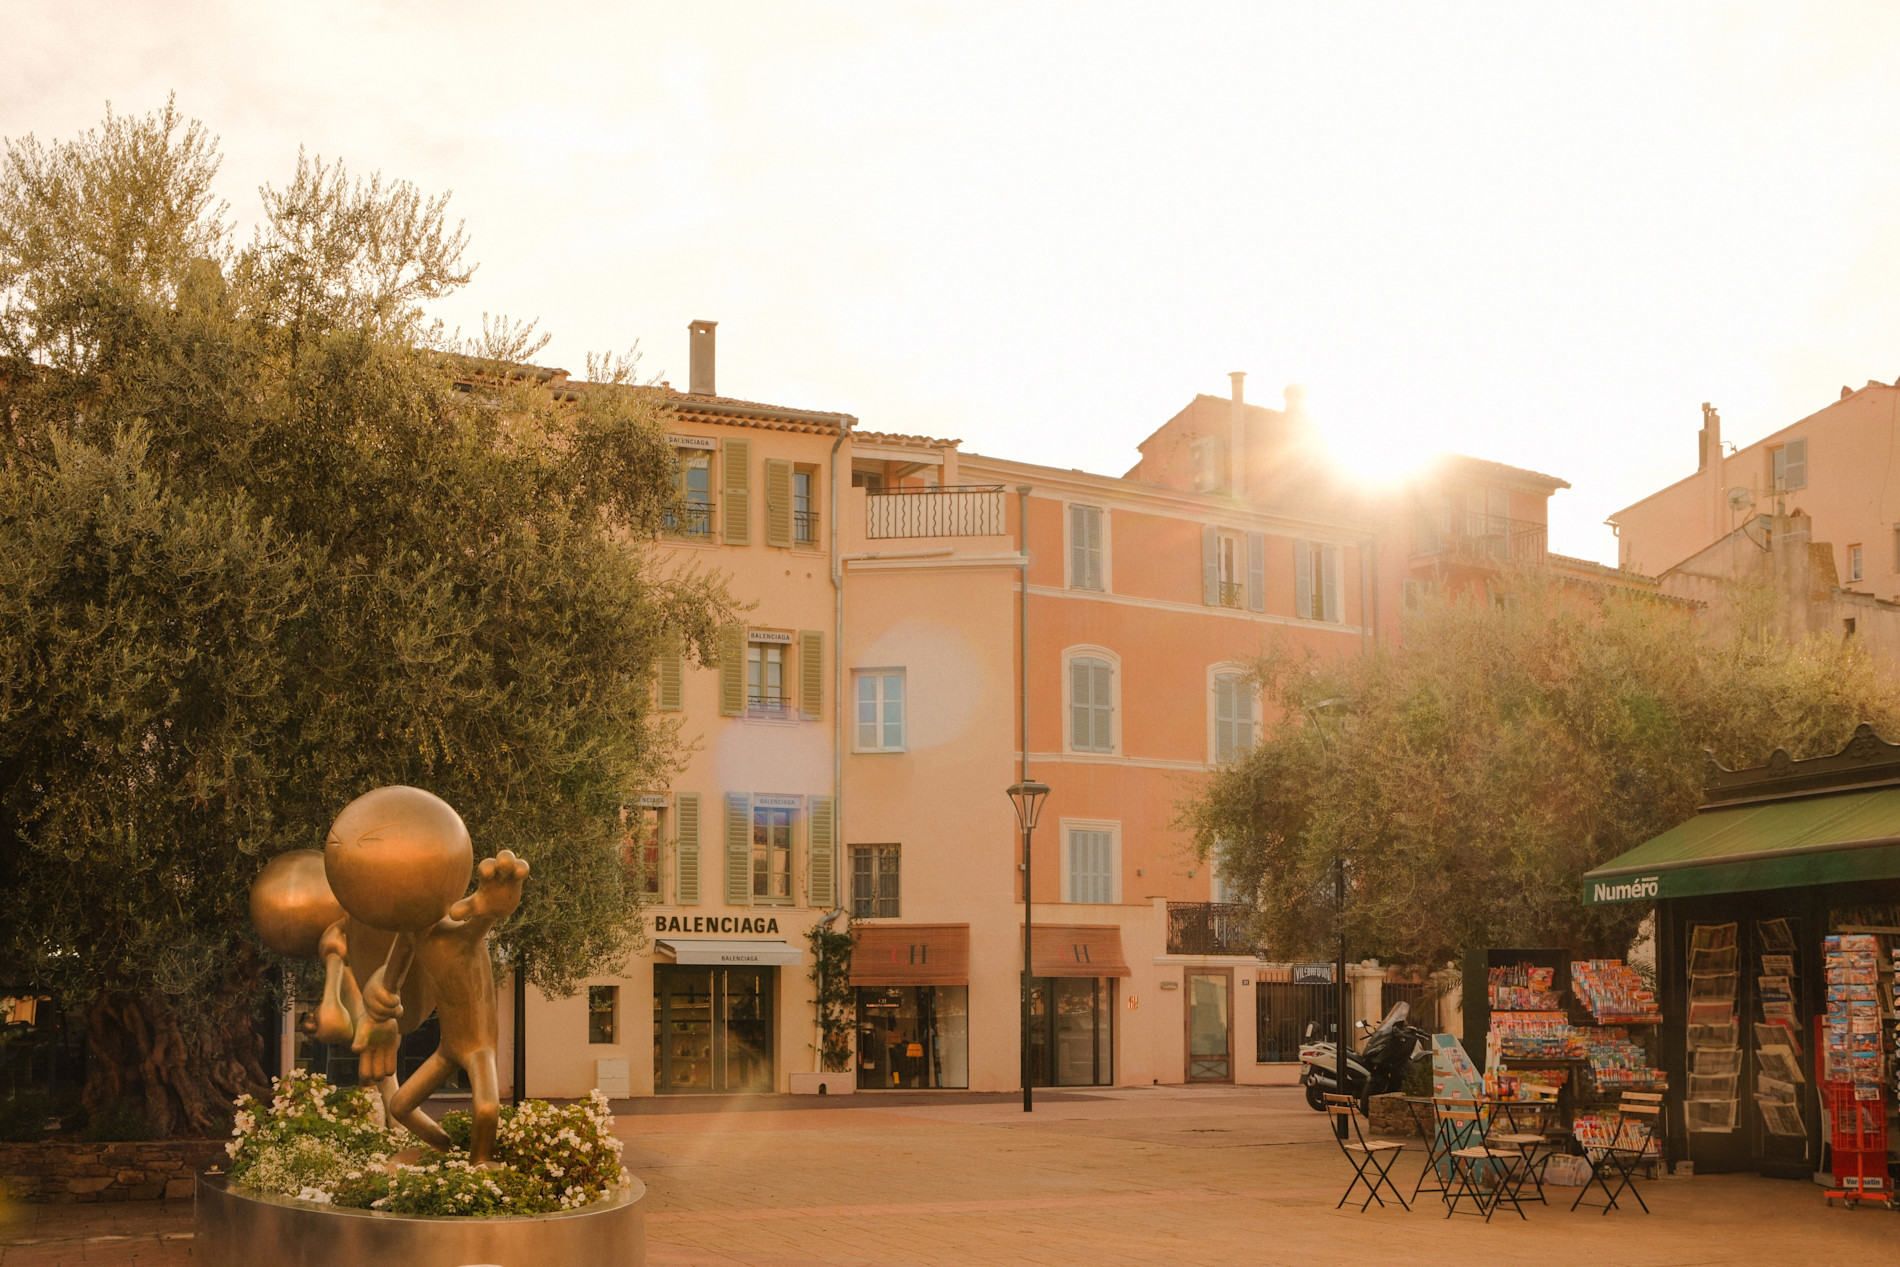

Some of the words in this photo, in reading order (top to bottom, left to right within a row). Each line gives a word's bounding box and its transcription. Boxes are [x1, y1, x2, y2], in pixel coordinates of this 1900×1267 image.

[750, 632, 790, 641] BALENCIAGA
[1593, 878, 1659, 902] Numéro
[655, 915, 779, 934] BALENCIAGA
